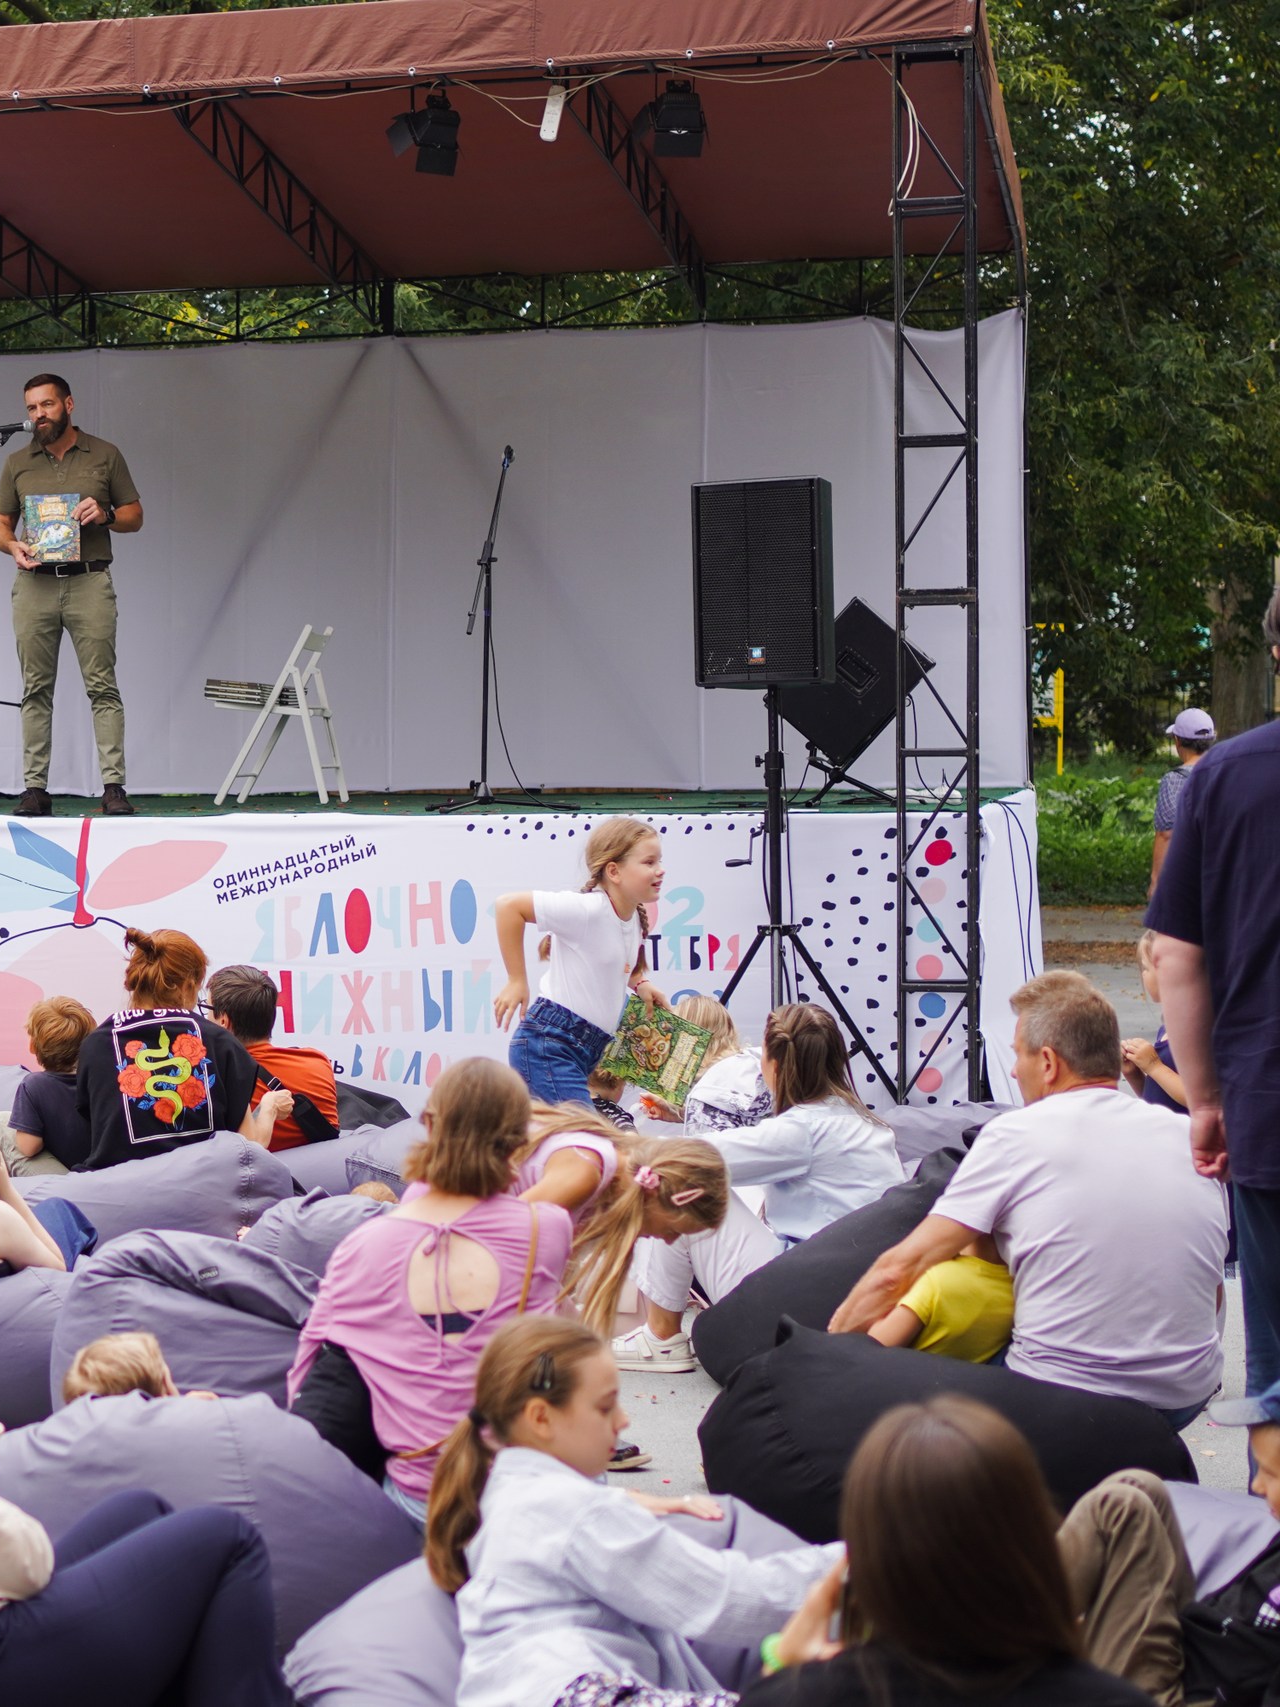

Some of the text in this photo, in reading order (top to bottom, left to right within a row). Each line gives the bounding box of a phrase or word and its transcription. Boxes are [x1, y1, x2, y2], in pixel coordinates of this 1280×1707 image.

[212, 834, 356, 889] ОДИННАДЦАТЫЙ
[216, 843, 377, 904] МЕЖДУНАРОДНЫЙ
[250, 878, 496, 963] ЯБЛОЧНО
[647, 933, 740, 971] ТЯБРЯ
[262, 958, 492, 1036] НИЖНЫЙ
[351, 1043, 451, 1088] В КОЛО
